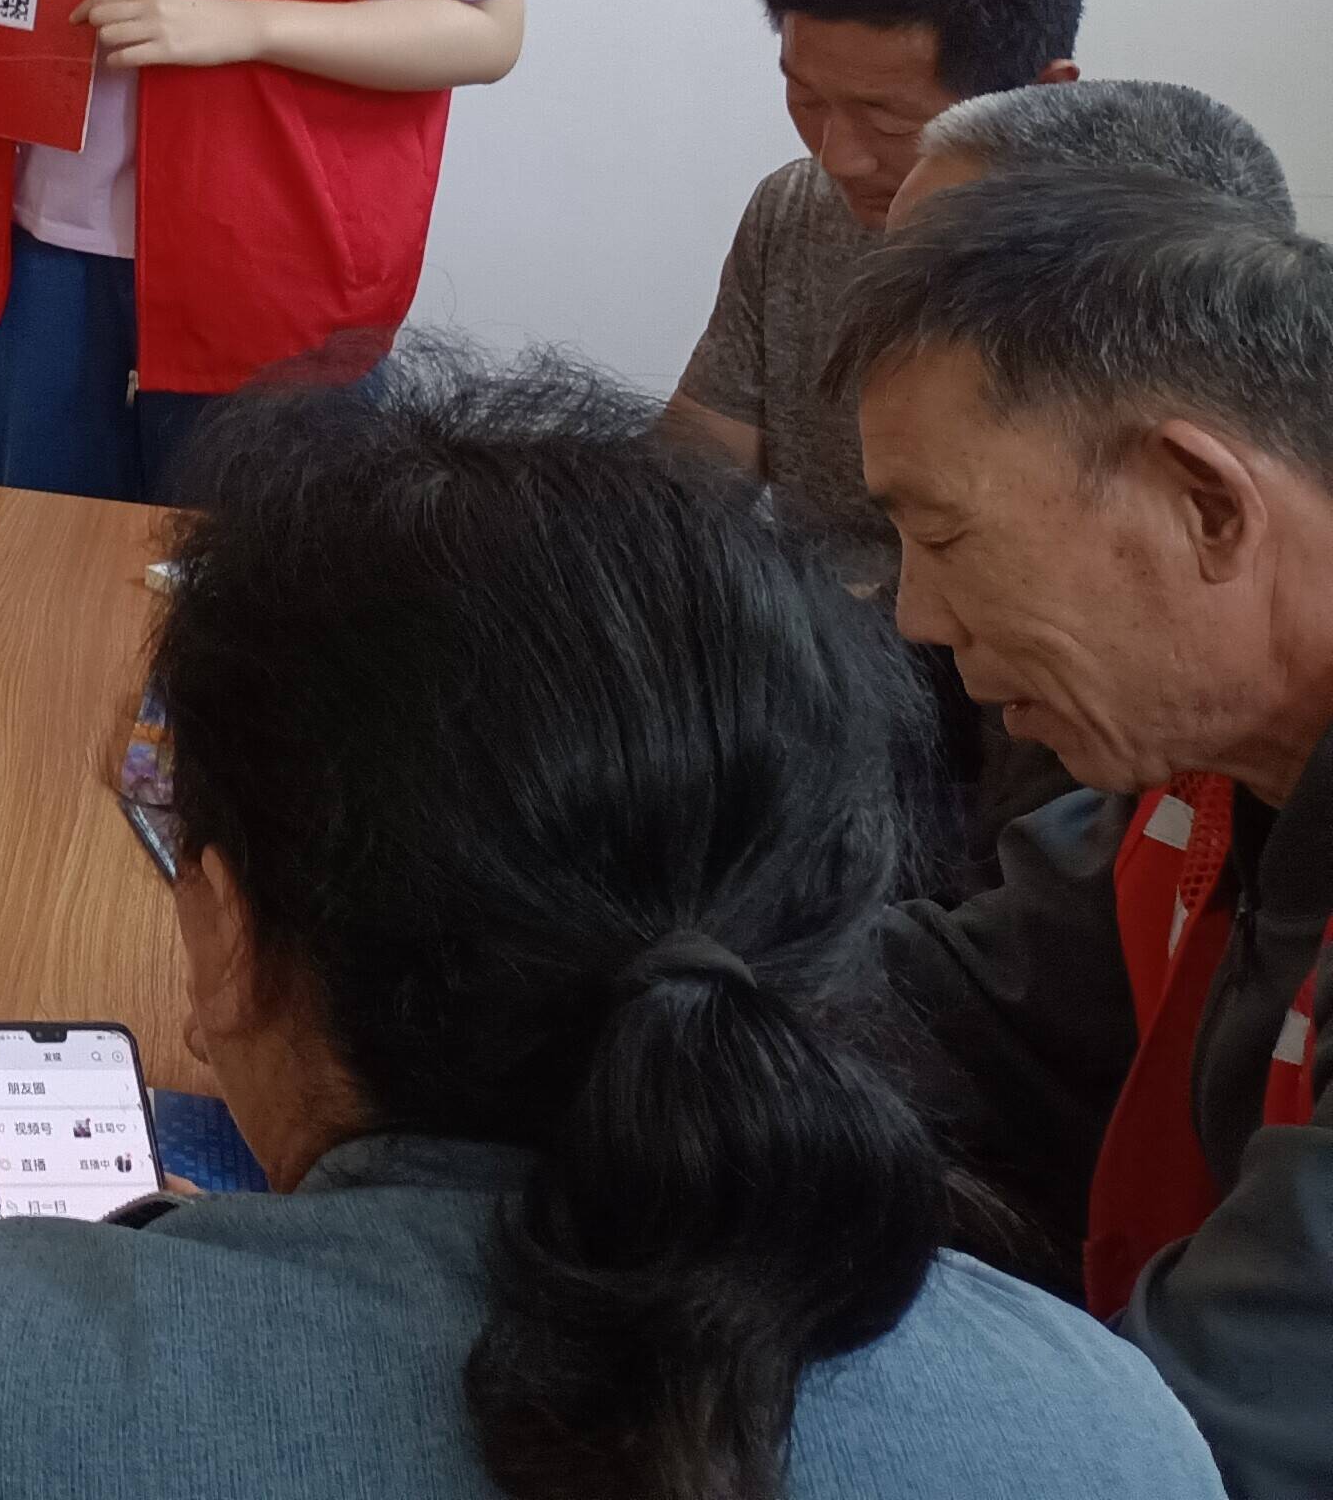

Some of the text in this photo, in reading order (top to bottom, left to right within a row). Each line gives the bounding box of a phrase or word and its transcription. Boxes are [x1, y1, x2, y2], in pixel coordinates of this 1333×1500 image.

[7, 1081, 46, 1095] 朋友圈
[14, 1122, 53, 1135] 视频号
[21, 1158, 47, 1172] 直播
